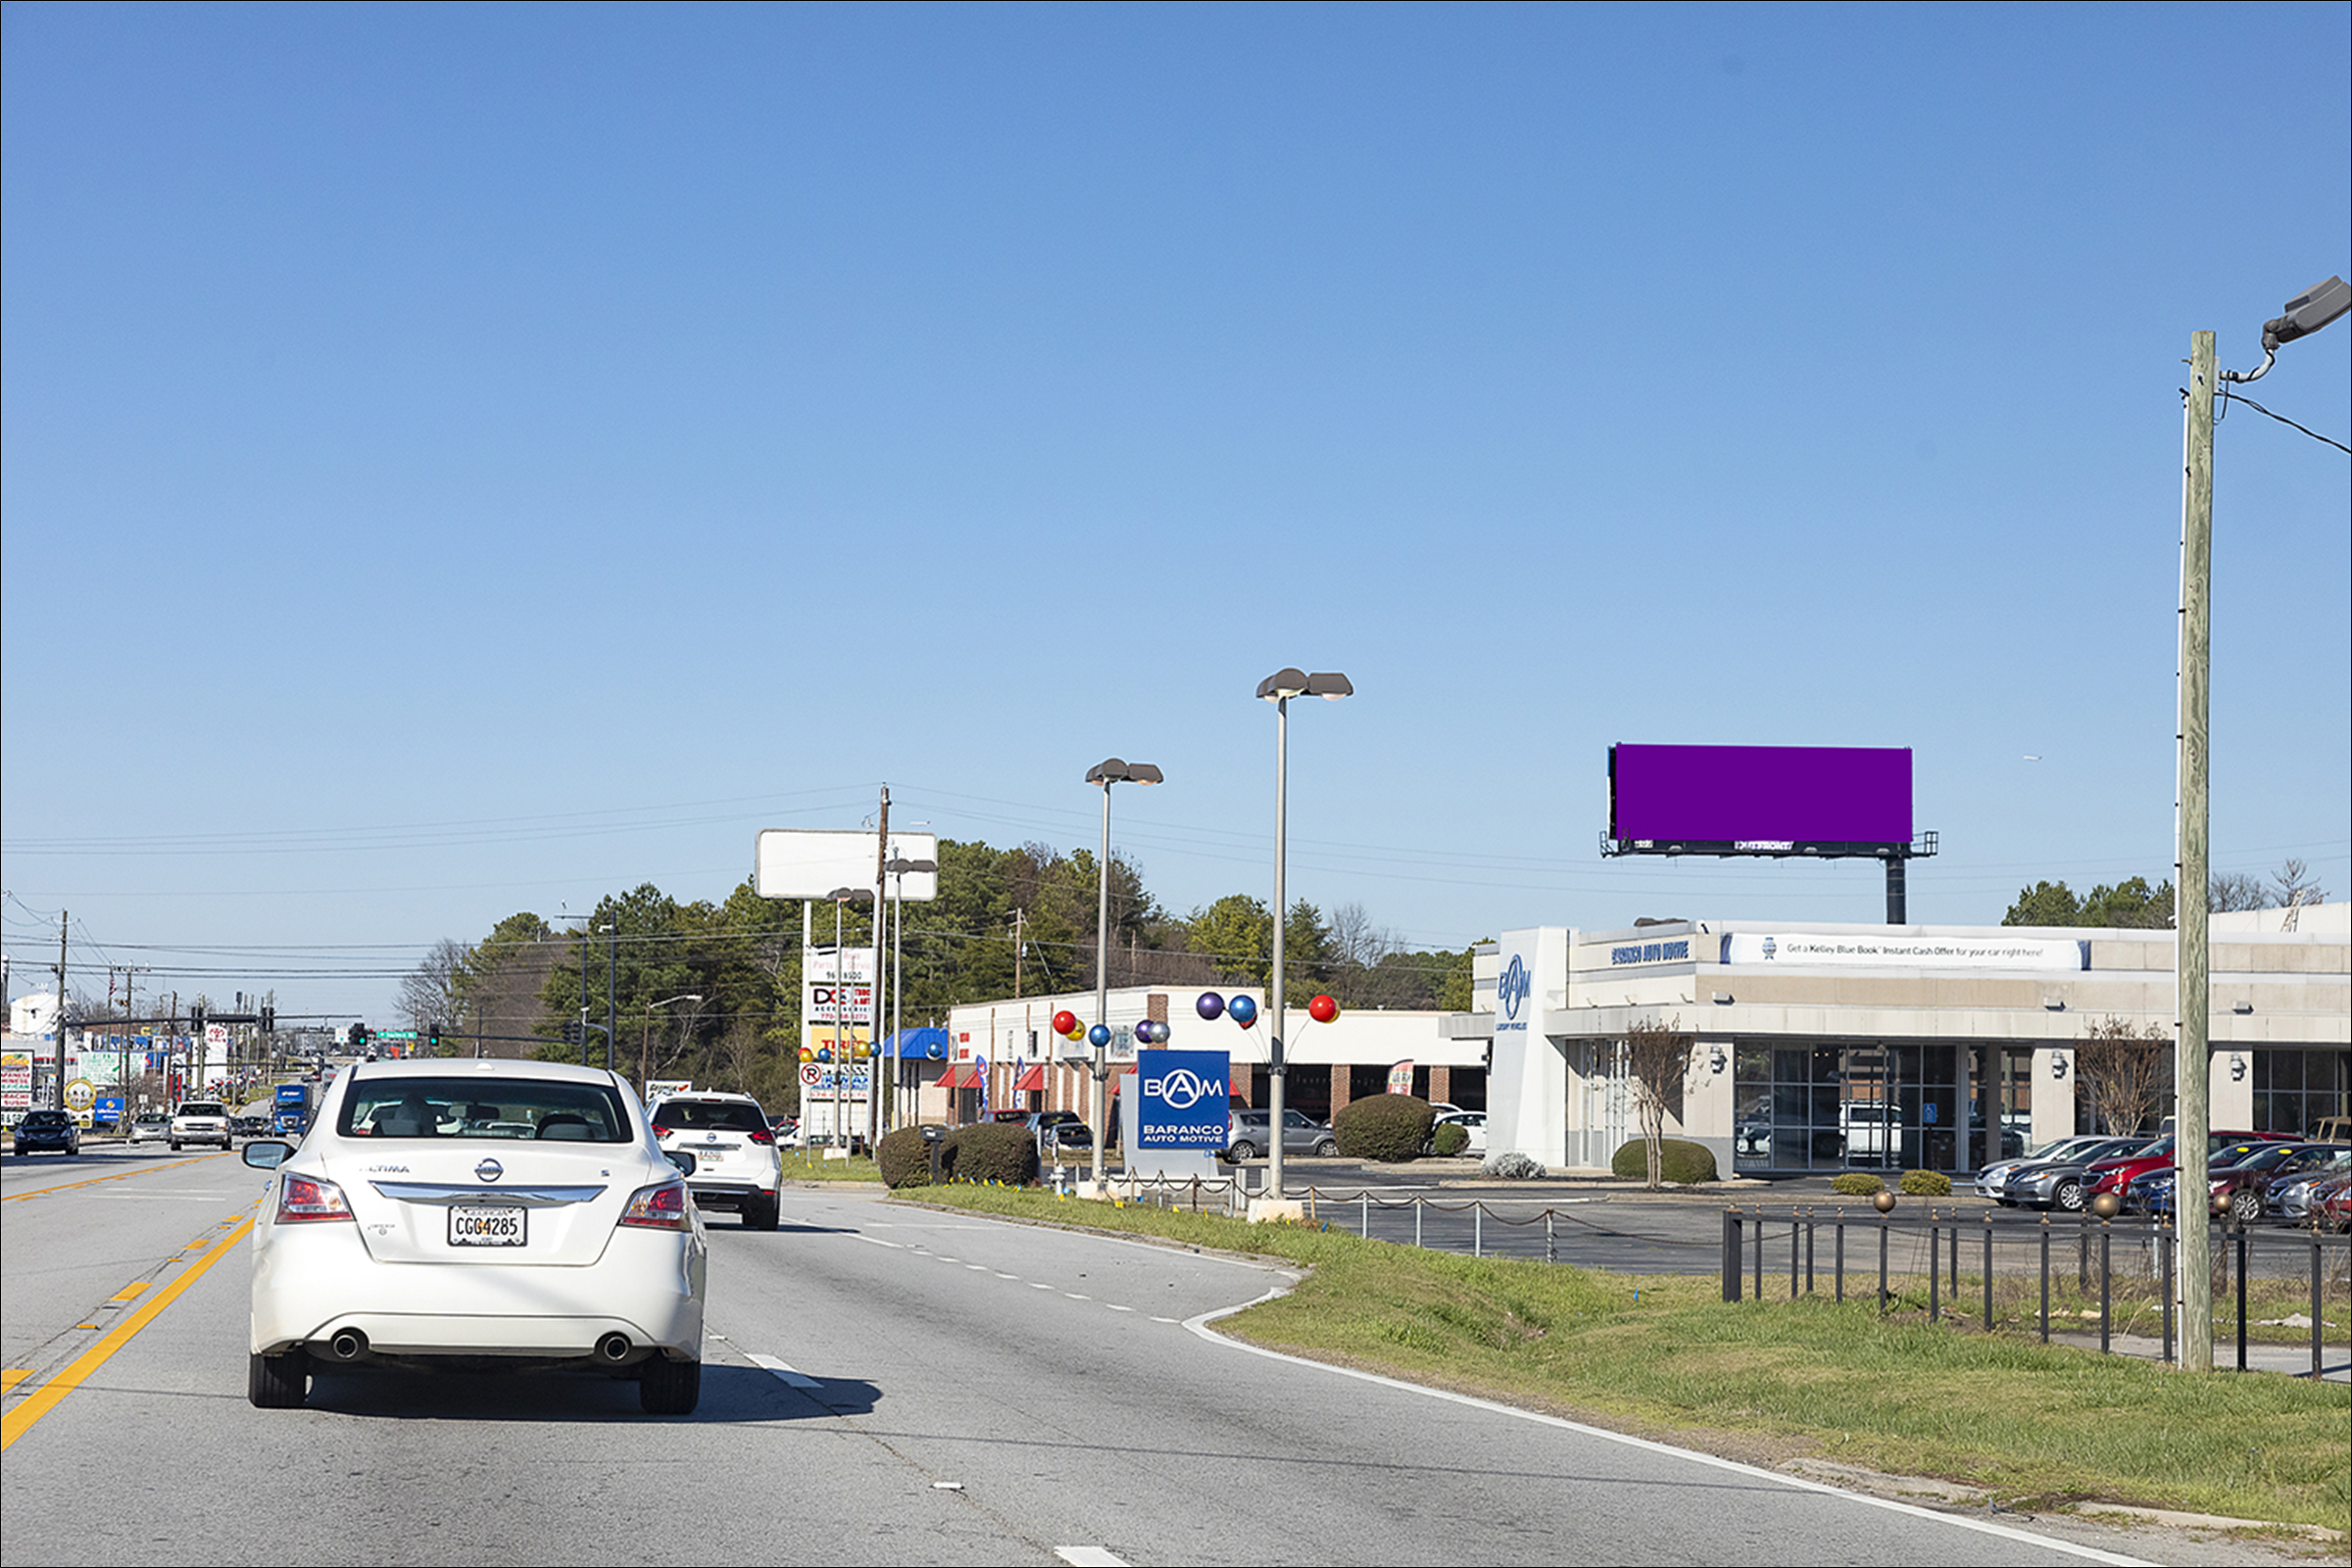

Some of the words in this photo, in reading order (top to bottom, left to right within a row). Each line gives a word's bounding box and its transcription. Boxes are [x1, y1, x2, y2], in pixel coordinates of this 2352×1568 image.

[1643, 943, 1661, 961] AUTO
[1787, 944, 1801, 953] Get
[1809, 945, 1836, 956] Kelley
[1837, 946, 1856, 955] Blue
[1883, 947, 1911, 956] Instant
[1912, 947, 1934, 956] Cash
[1935, 947, 1954, 956] Offer
[1956, 948, 1968, 956] for
[1969, 949, 1987, 958] your
[2002, 949, 2022, 959] right
[1498, 954, 1531, 1020] BAM
[1144, 1069, 1224, 1109] BAM
[1144, 1125, 1224, 1135] BARANCO
[1144, 1135, 1176, 1144] AUTO
[1179, 1135, 1223, 1144] MOTIVE
